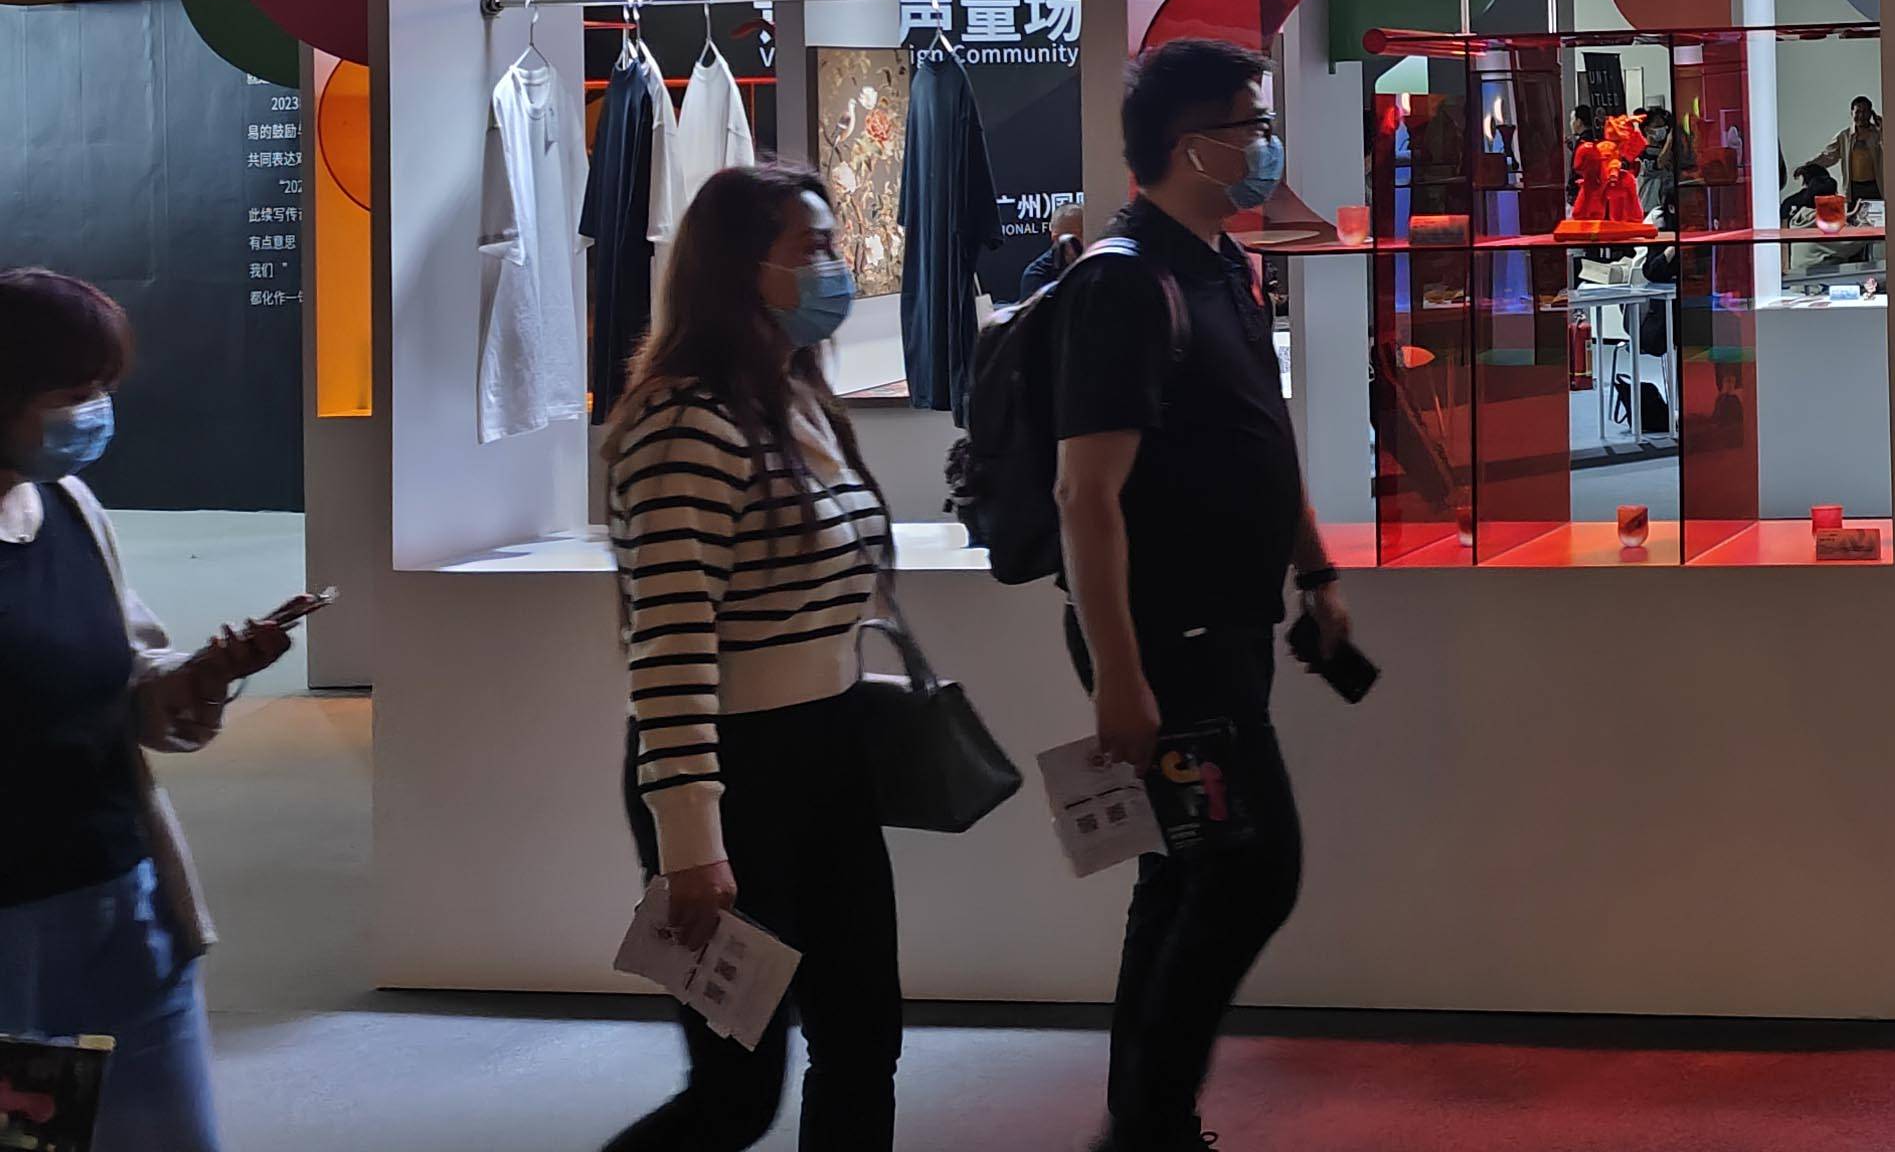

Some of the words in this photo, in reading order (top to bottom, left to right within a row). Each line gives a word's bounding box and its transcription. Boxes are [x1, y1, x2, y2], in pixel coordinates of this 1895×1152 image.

[952, 44, 1079, 67] Community
[271, 96, 299, 111] 2023
[249, 235, 296, 250] 有点意思
